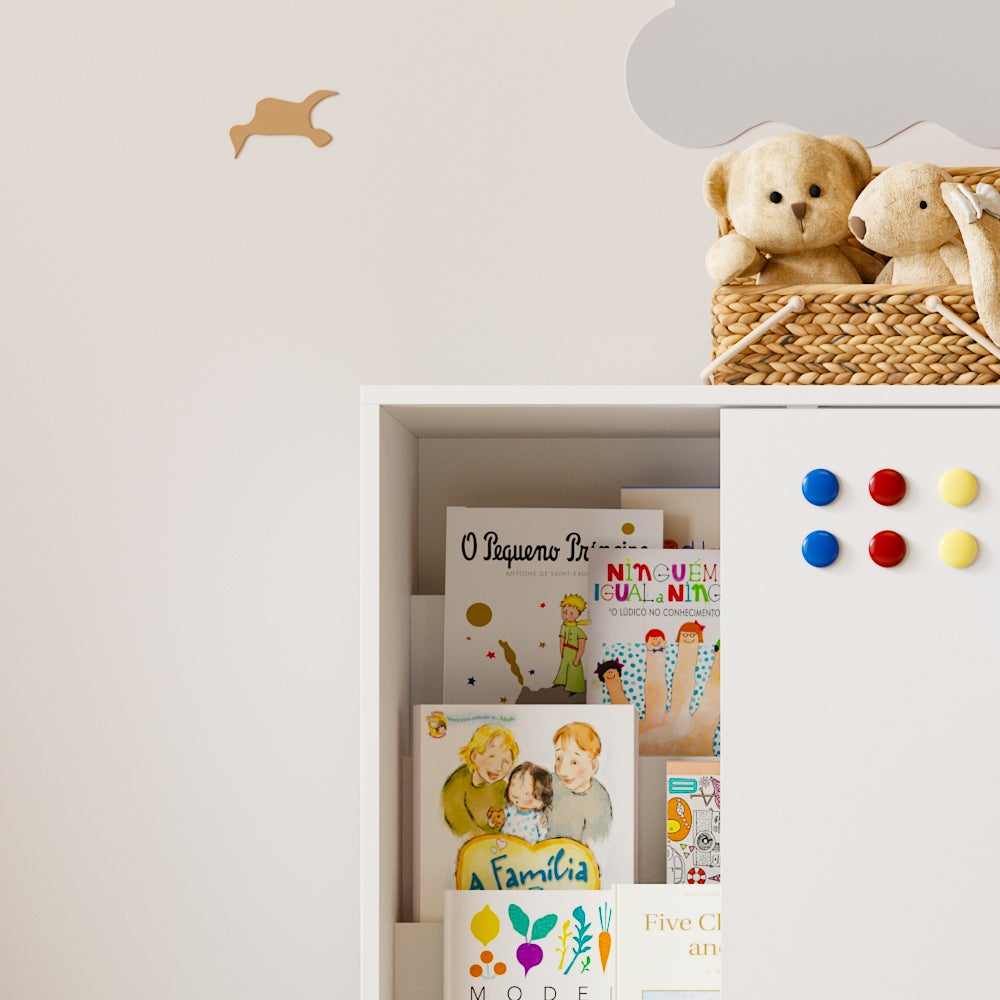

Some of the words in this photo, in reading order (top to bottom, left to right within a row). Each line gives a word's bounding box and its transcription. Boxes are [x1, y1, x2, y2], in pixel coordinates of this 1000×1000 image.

[461, 531, 477, 561] O
[483, 531, 560, 569] Pequeno
[594, 582, 654, 603] IGUAL
[655, 593, 665, 603] a
[619, 607, 647, 617] LÚDICO
[649, 608, 661, 617] NO
[663, 608, 720, 617] CONHECIMENTO
[490, 848, 588, 890] Família
[644, 913, 692, 931] Five
[688, 943, 720, 956] an
